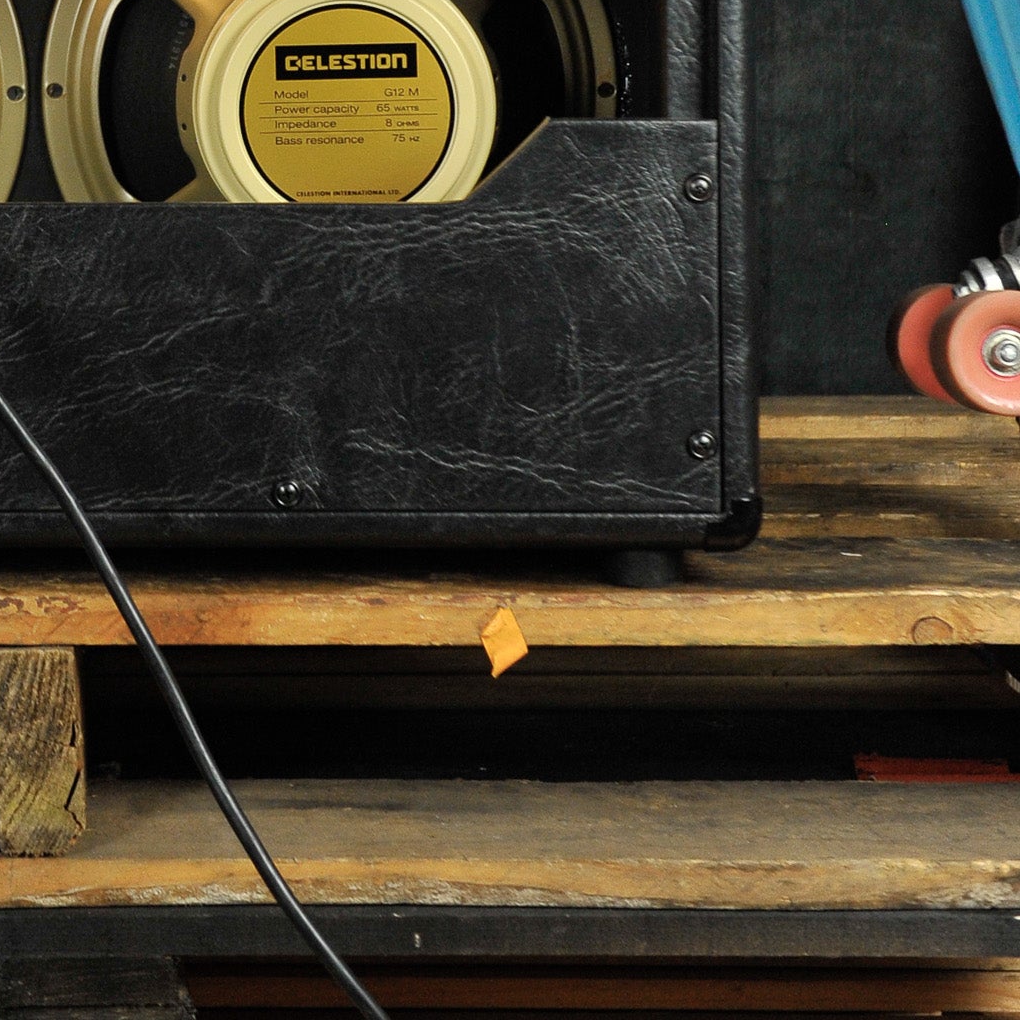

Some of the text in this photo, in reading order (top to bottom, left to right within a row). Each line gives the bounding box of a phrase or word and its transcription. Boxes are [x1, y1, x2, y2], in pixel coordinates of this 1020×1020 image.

[285, 53, 408, 71] CELESTION
[274, 90, 309, 99] Model
[384, 88, 419, 97] G12 M
[275, 104, 360, 115] Power capacity
[376, 104, 390, 112] 65
[275, 120, 337, 130] Impedance
[385, 119, 392, 127] 8
[275, 135, 364, 145] Bass resonance
[393, 134, 405, 142] 75
